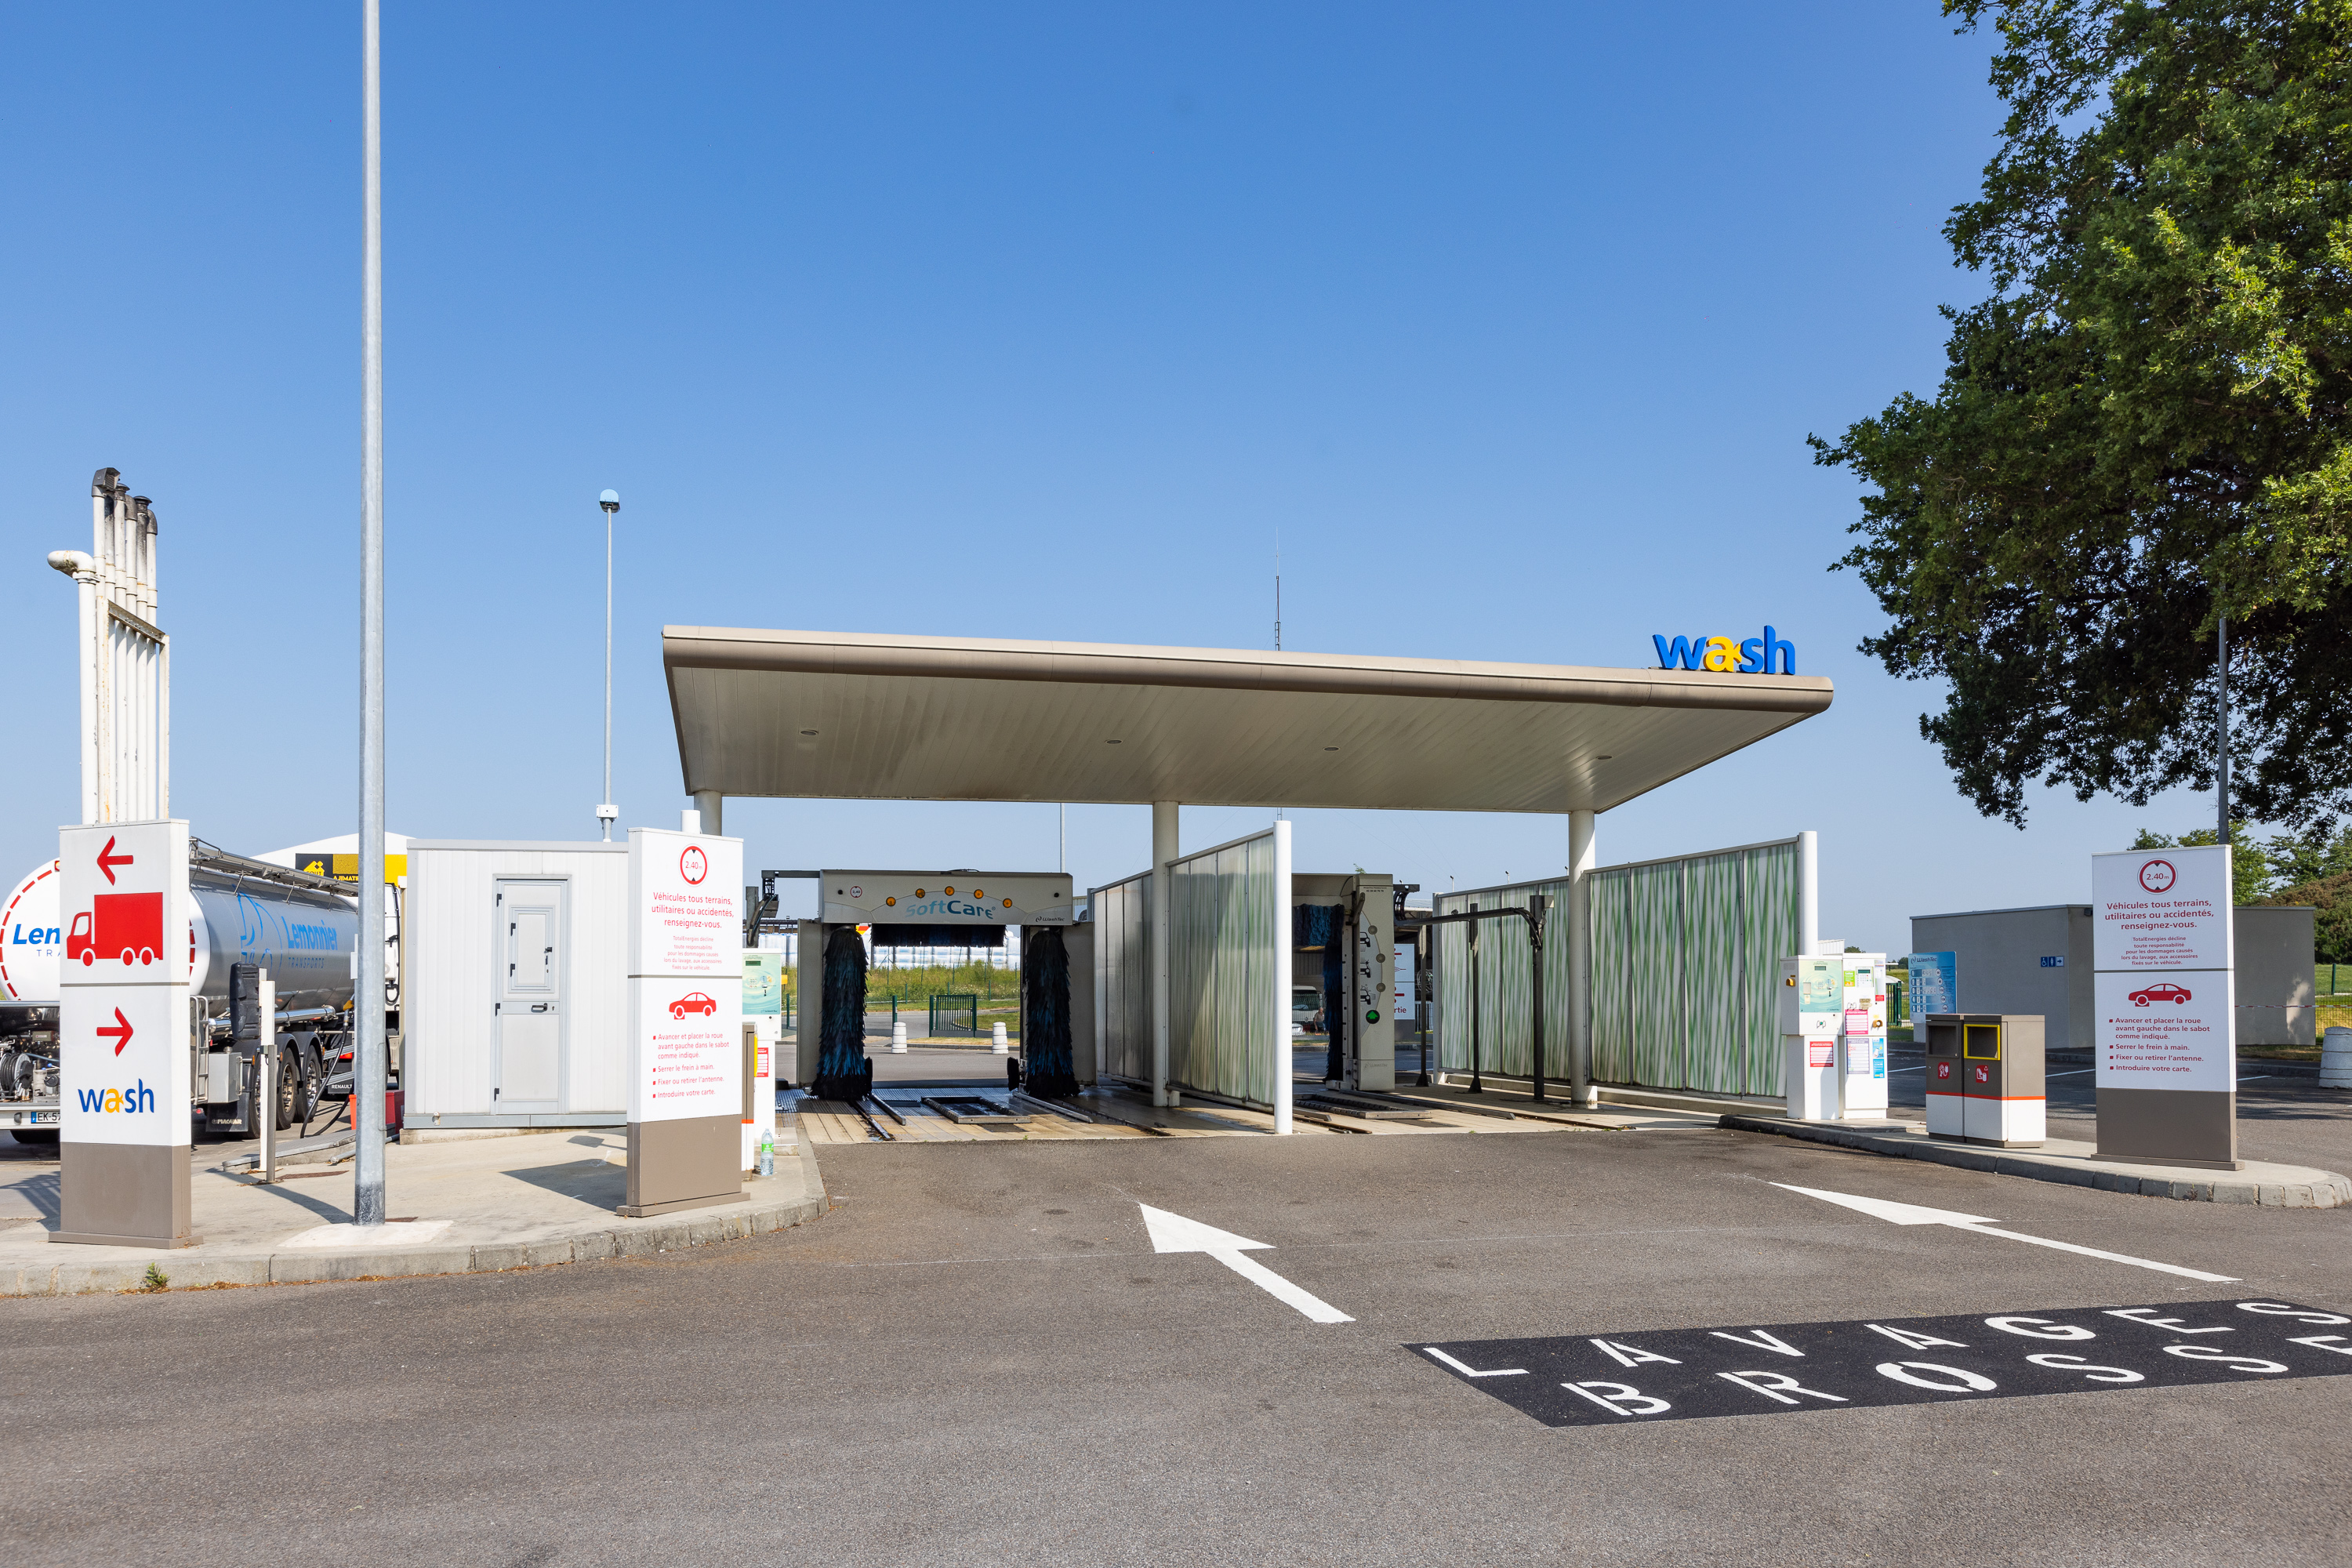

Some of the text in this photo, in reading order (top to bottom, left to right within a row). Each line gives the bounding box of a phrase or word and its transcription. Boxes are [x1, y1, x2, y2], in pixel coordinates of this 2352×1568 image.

[1652, 625, 1795, 675] wash
[653, 892, 686, 902] Véhicules
[705, 896, 733, 906] terrains,
[652, 905, 684, 914] utilitaires
[697, 908, 734, 918] accidentés,
[2164, 909, 2214, 918] accidentés,
[664, 919, 722, 928] renseignez-vous.
[2121, 921, 2197, 931] renseignez-vous.
[281, 916, 338, 950] Lemonnier
[289, 957, 325, 969] TRANSPORTS
[675, 1042, 694, 1051] gauche
[78, 1078, 154, 1113] wash
